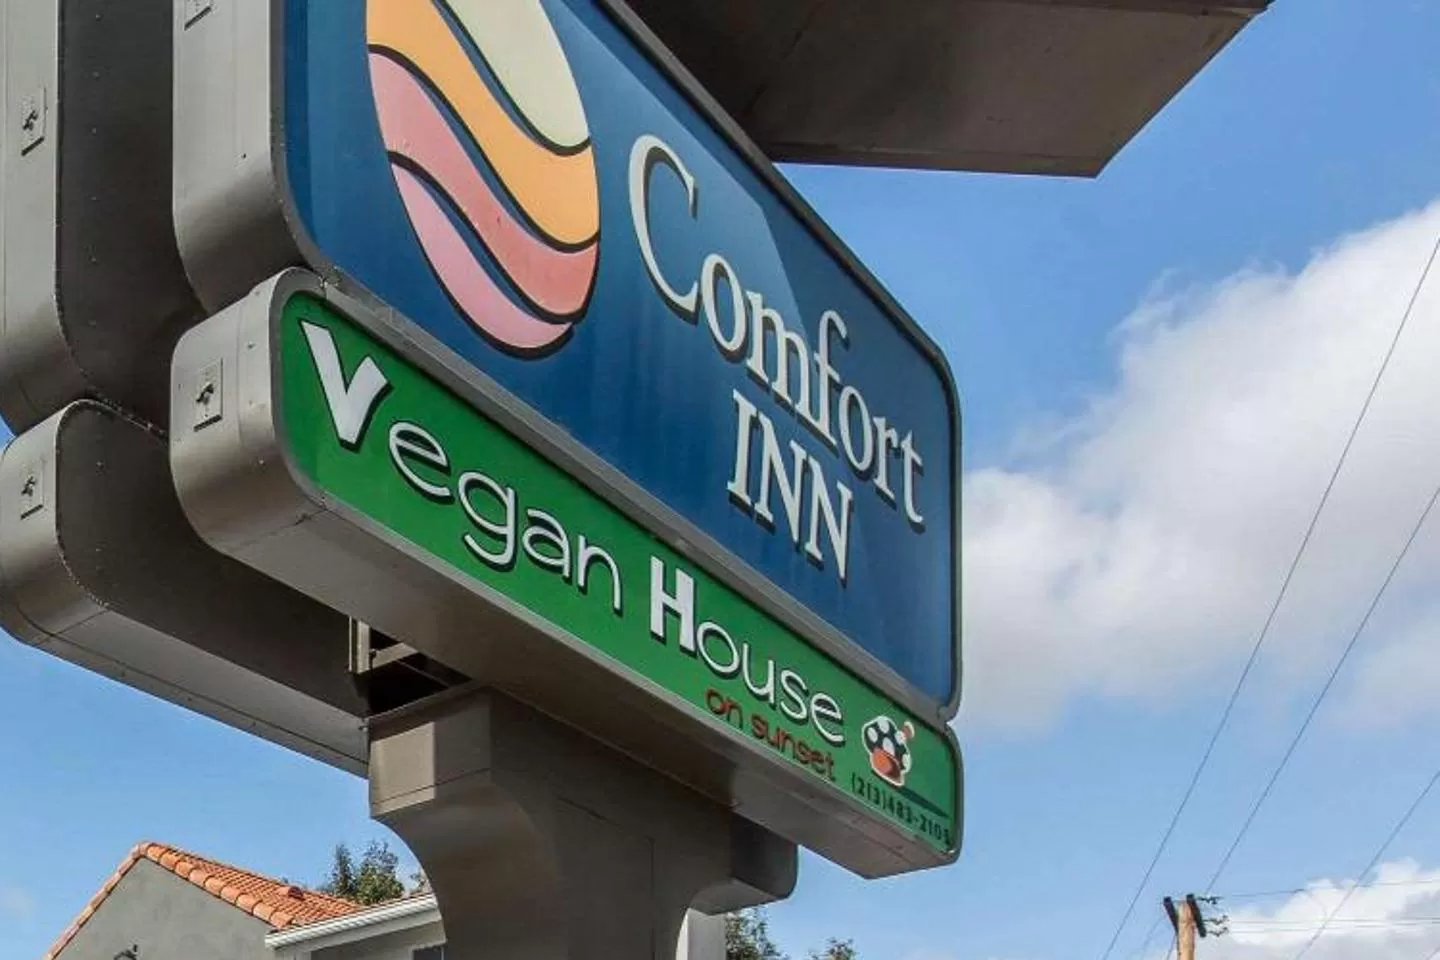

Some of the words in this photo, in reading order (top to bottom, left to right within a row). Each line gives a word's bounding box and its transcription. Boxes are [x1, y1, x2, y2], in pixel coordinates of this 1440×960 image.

[628, 134, 924, 524] Comfort
[302, 319, 623, 614] Vegan
[649, 554, 846, 747] House
[726, 388, 853, 582] INN
[704, 687, 744, 731] on
[750, 713, 836, 782] sunset
